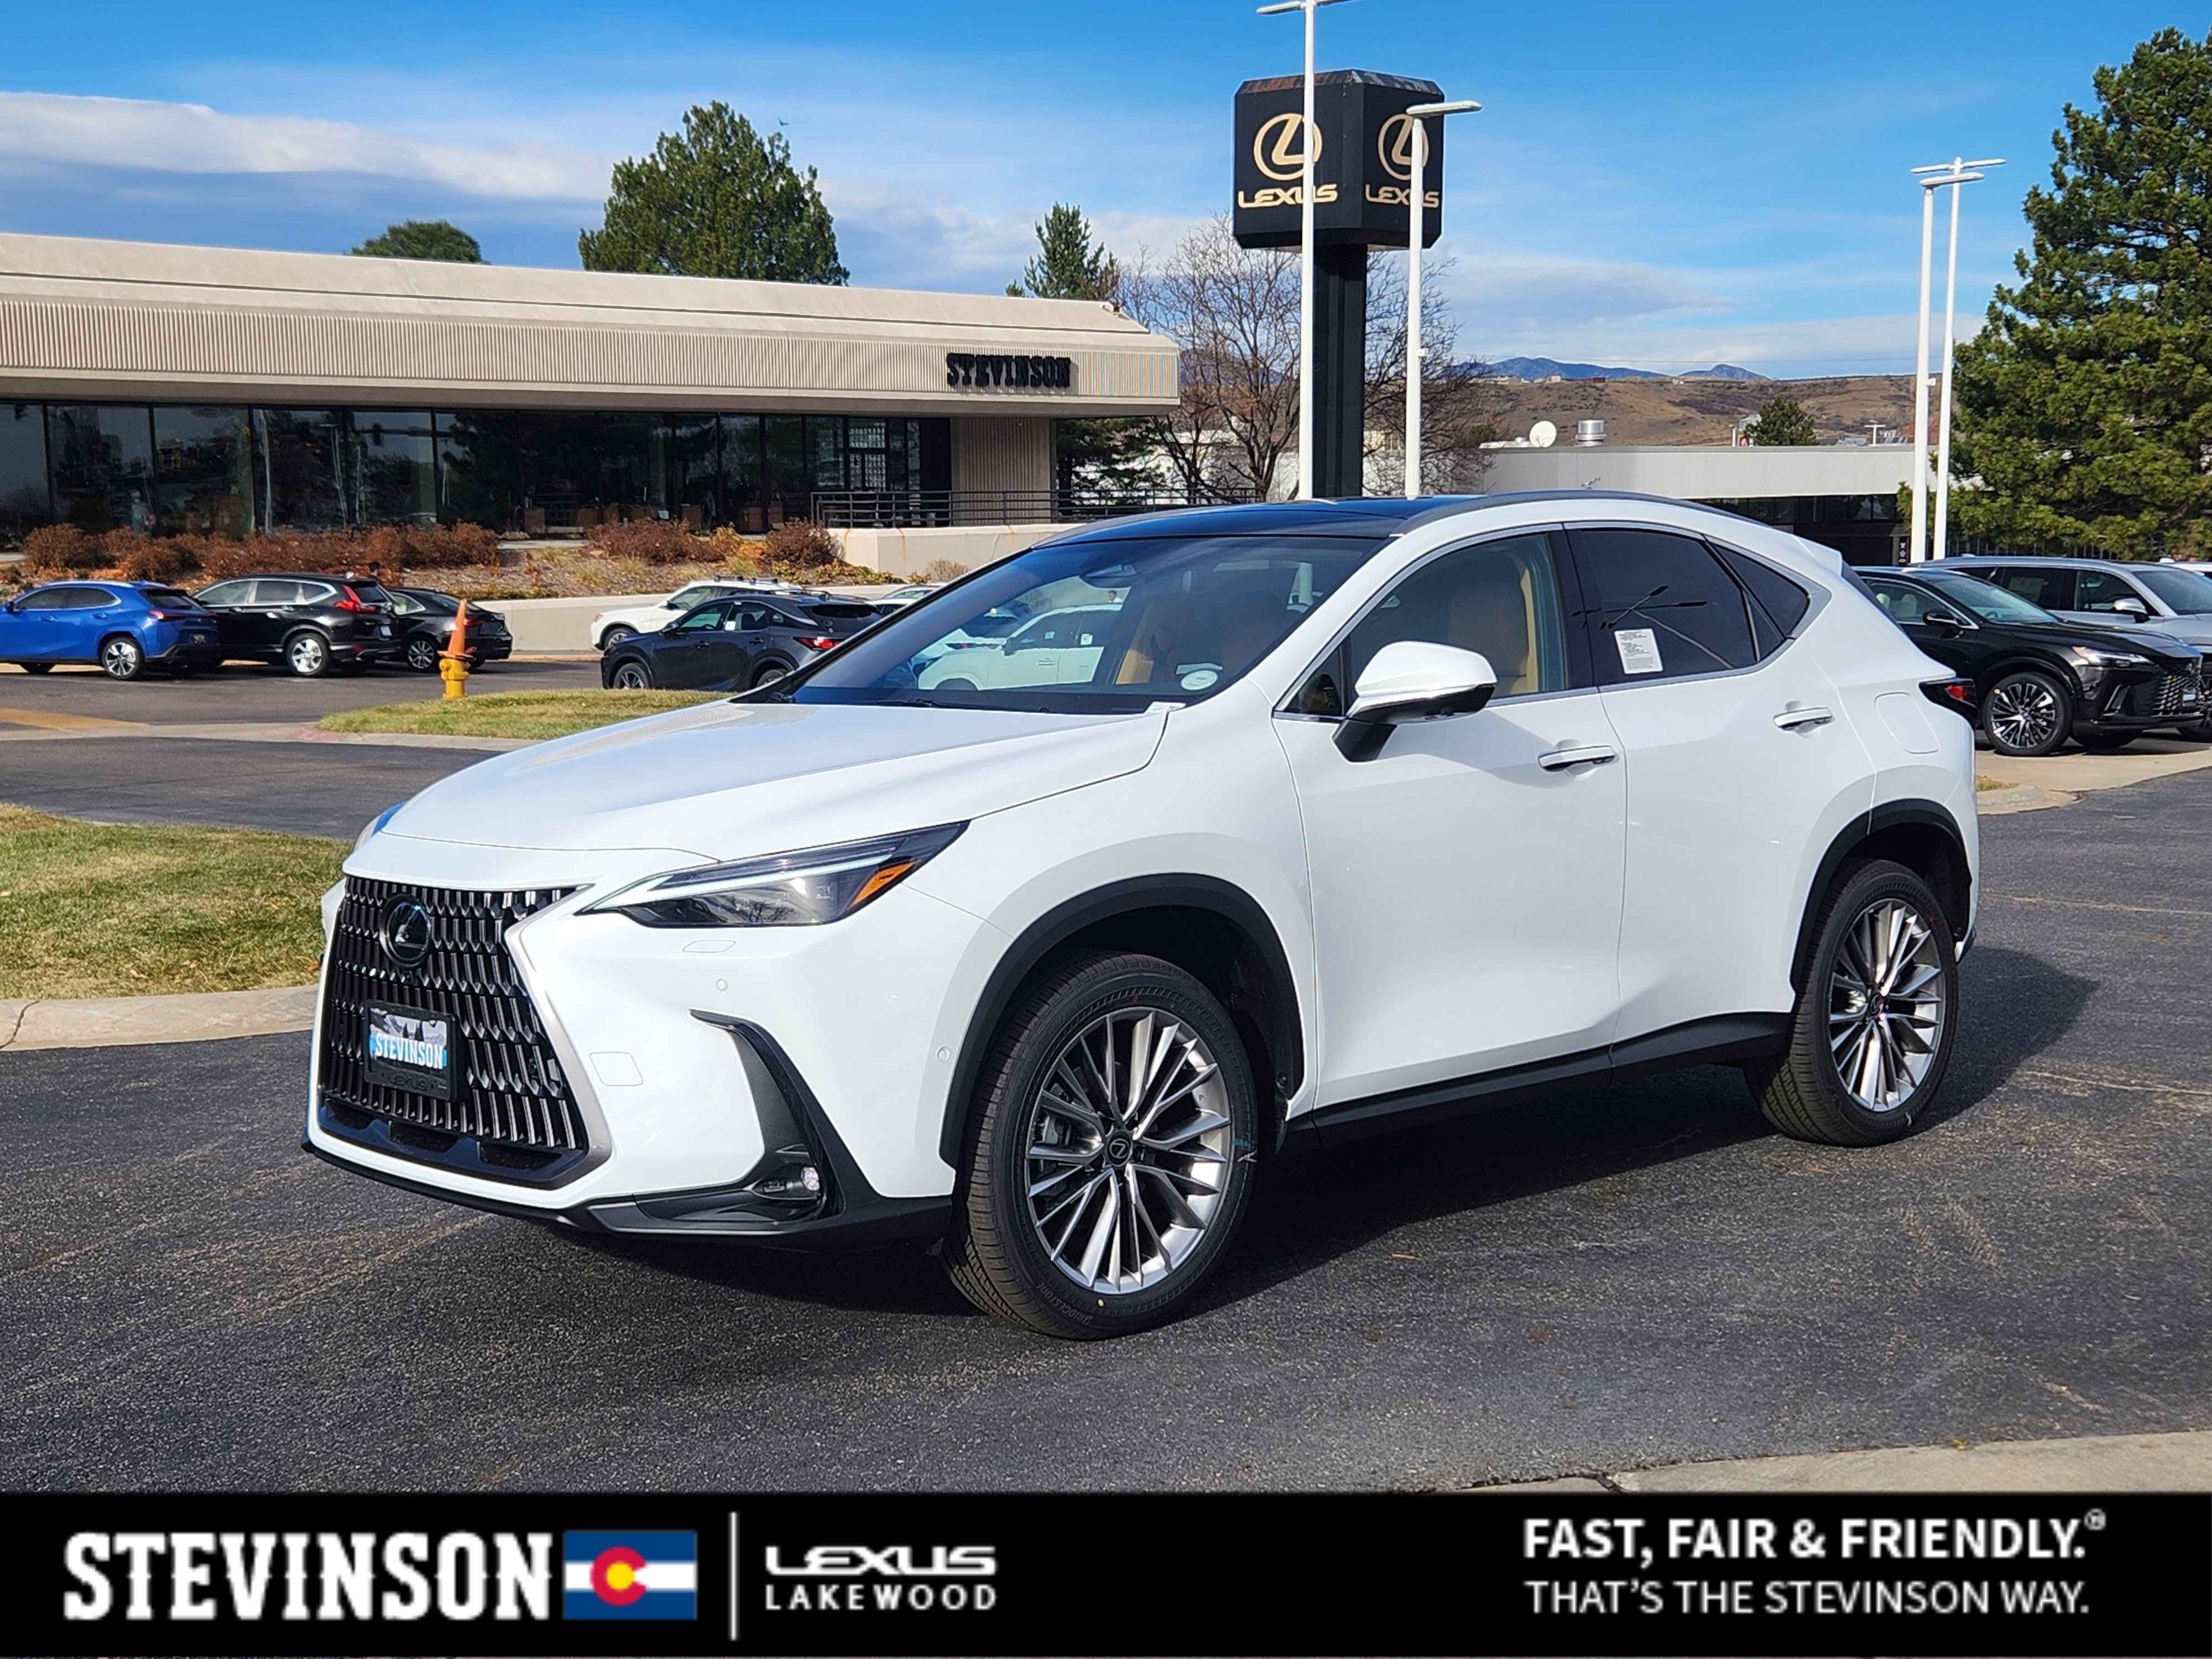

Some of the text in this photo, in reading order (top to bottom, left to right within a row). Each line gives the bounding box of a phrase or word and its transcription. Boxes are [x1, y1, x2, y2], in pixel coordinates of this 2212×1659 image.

[1365, 184, 1439, 208] LEXS
[946, 353, 1071, 388] STEVINSON
[375, 1033, 443, 1069] STEVINSON
